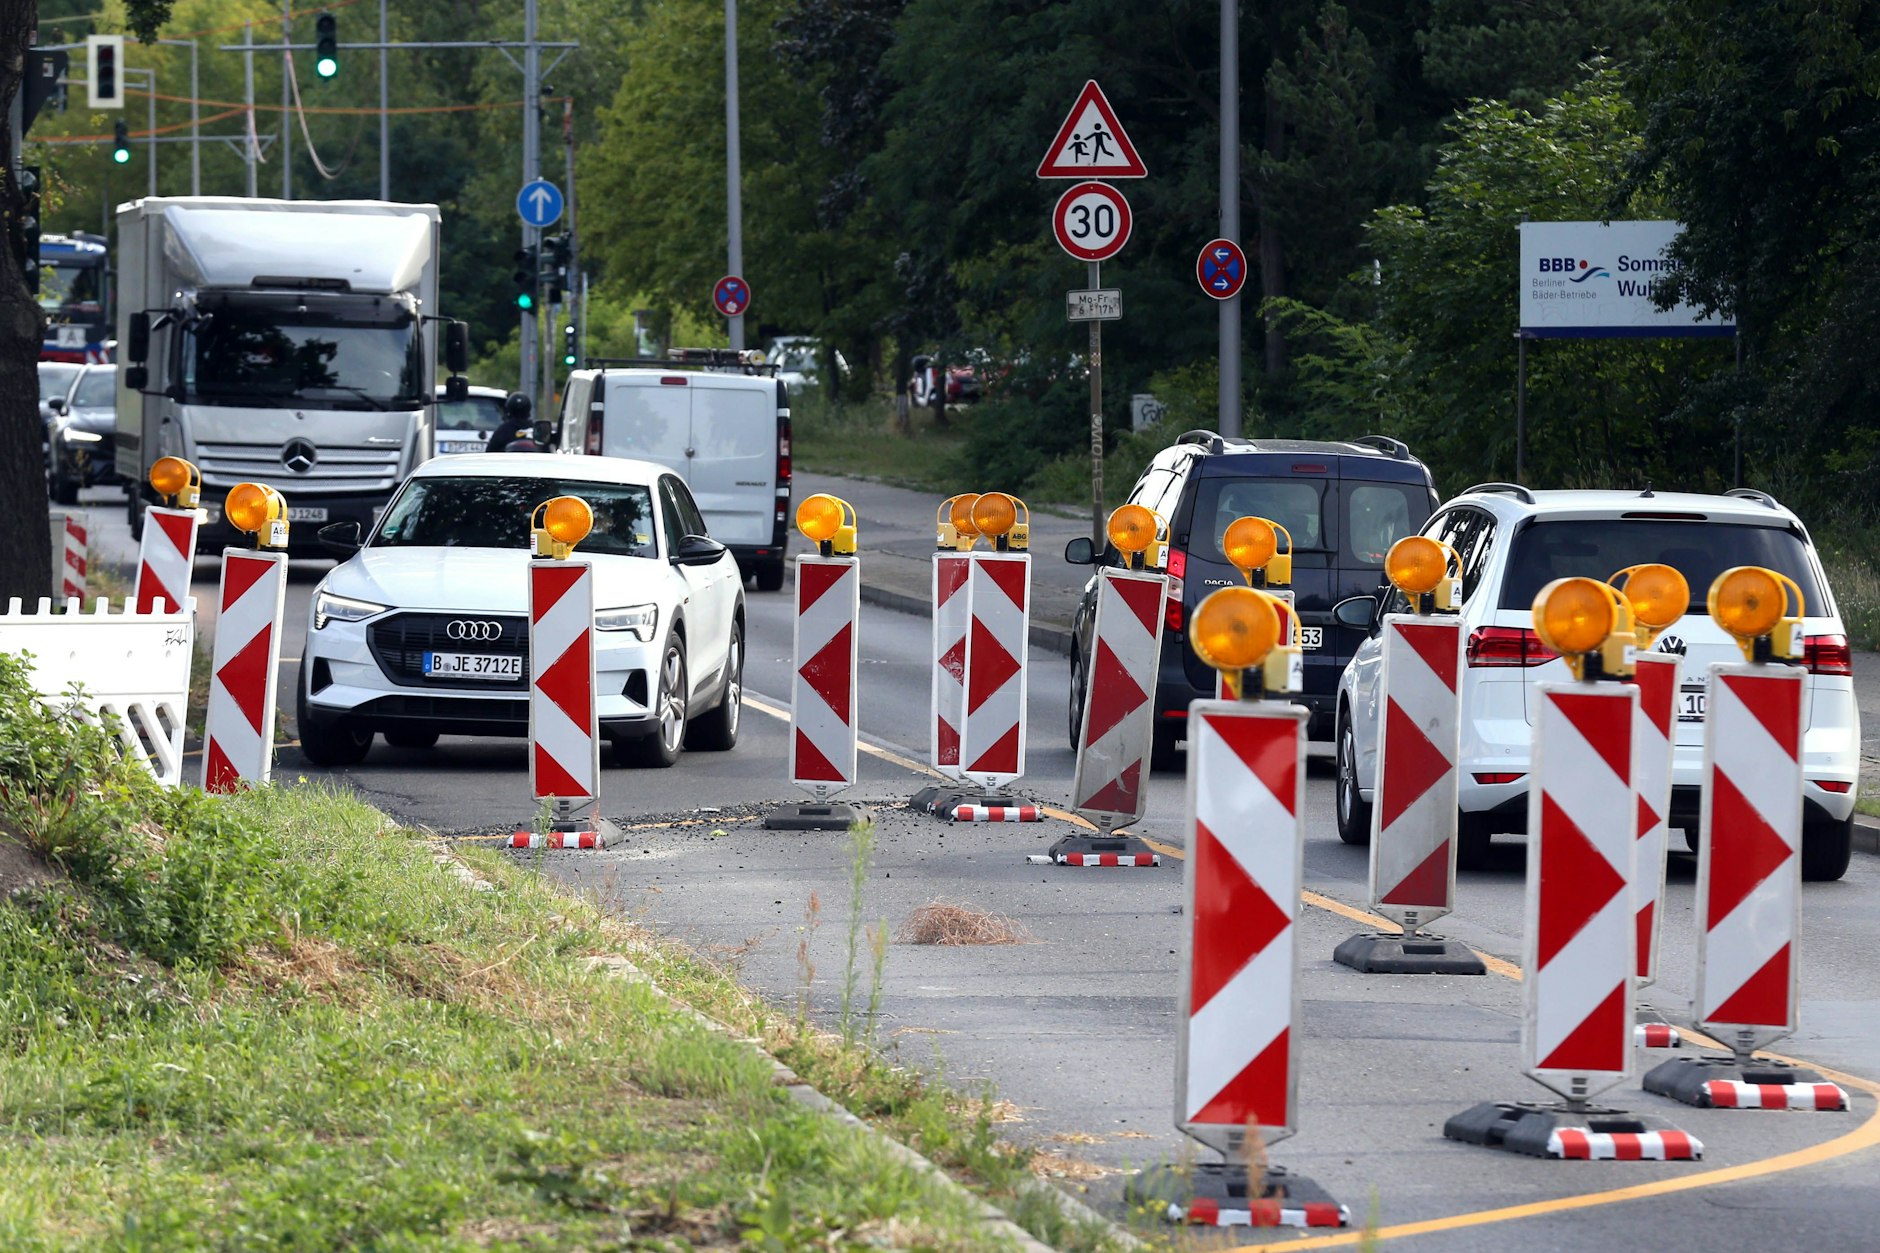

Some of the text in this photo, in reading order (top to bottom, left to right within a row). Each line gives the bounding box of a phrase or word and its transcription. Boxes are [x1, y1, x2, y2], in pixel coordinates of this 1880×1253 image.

[1071, 204, 1114, 239] 30
[1539, 258, 1576, 272] BBB
[1532, 278, 1566, 288] Berliner
[1532, 290, 1597, 300] Bäder-Betriebe
[433, 655, 520, 674] B JE 3712E
